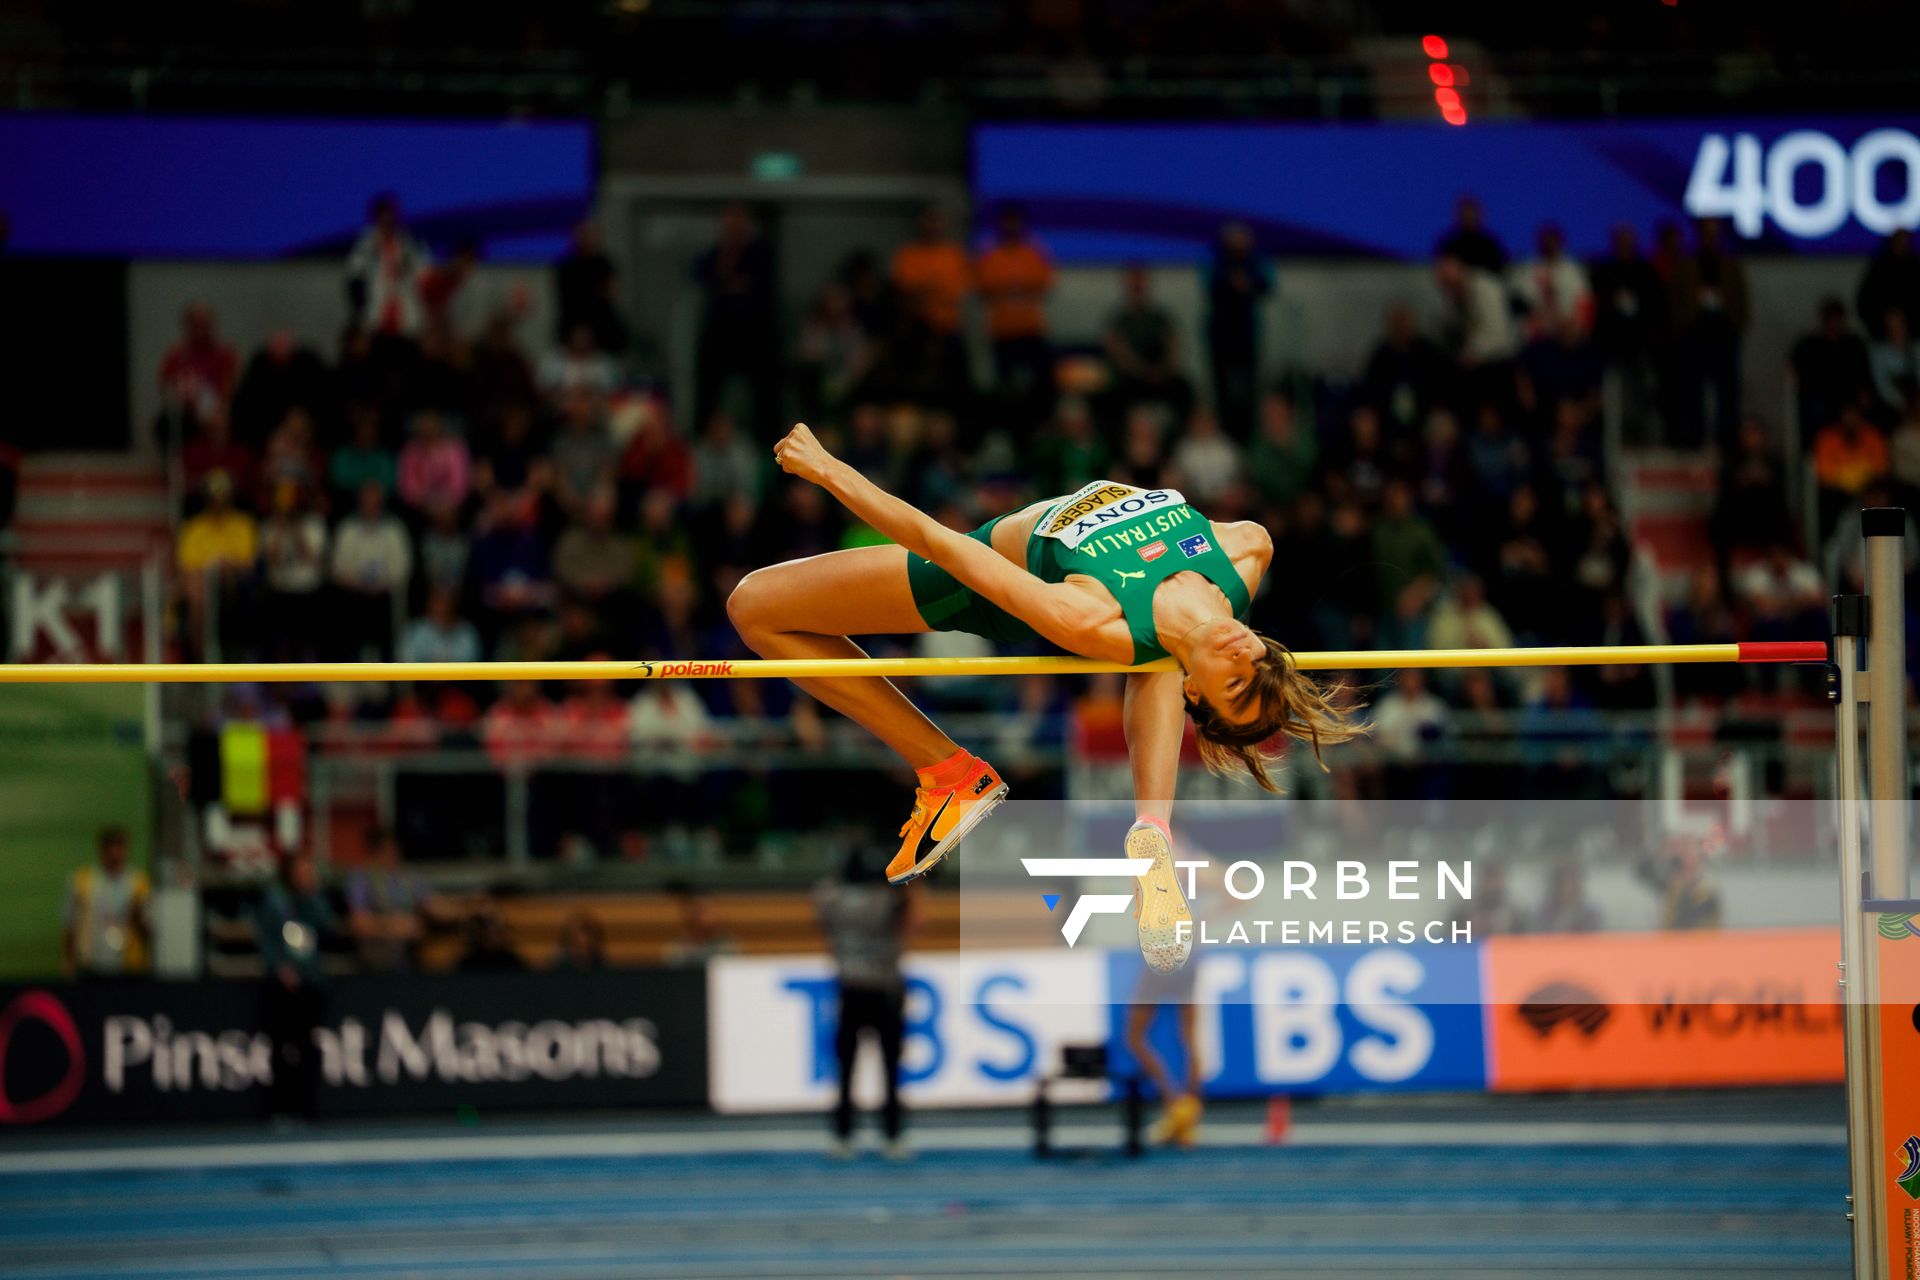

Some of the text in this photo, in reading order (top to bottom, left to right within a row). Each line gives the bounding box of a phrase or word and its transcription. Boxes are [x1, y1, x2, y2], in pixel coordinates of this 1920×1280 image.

[1684, 126, 1920, 239] 400
[1049, 485, 1133, 535] SLAGERS
[1075, 490, 1169, 537] SONY
[1079, 504, 1192, 558] AUSTRALIA
[13, 571, 118, 656] K1
[660, 661, 732, 677] polanik
[783, 975, 1037, 1086] TBS
[1193, 949, 1436, 1084] TBS
[1638, 980, 1845, 1039] WORL
[378, 1007, 661, 1084] Masons
